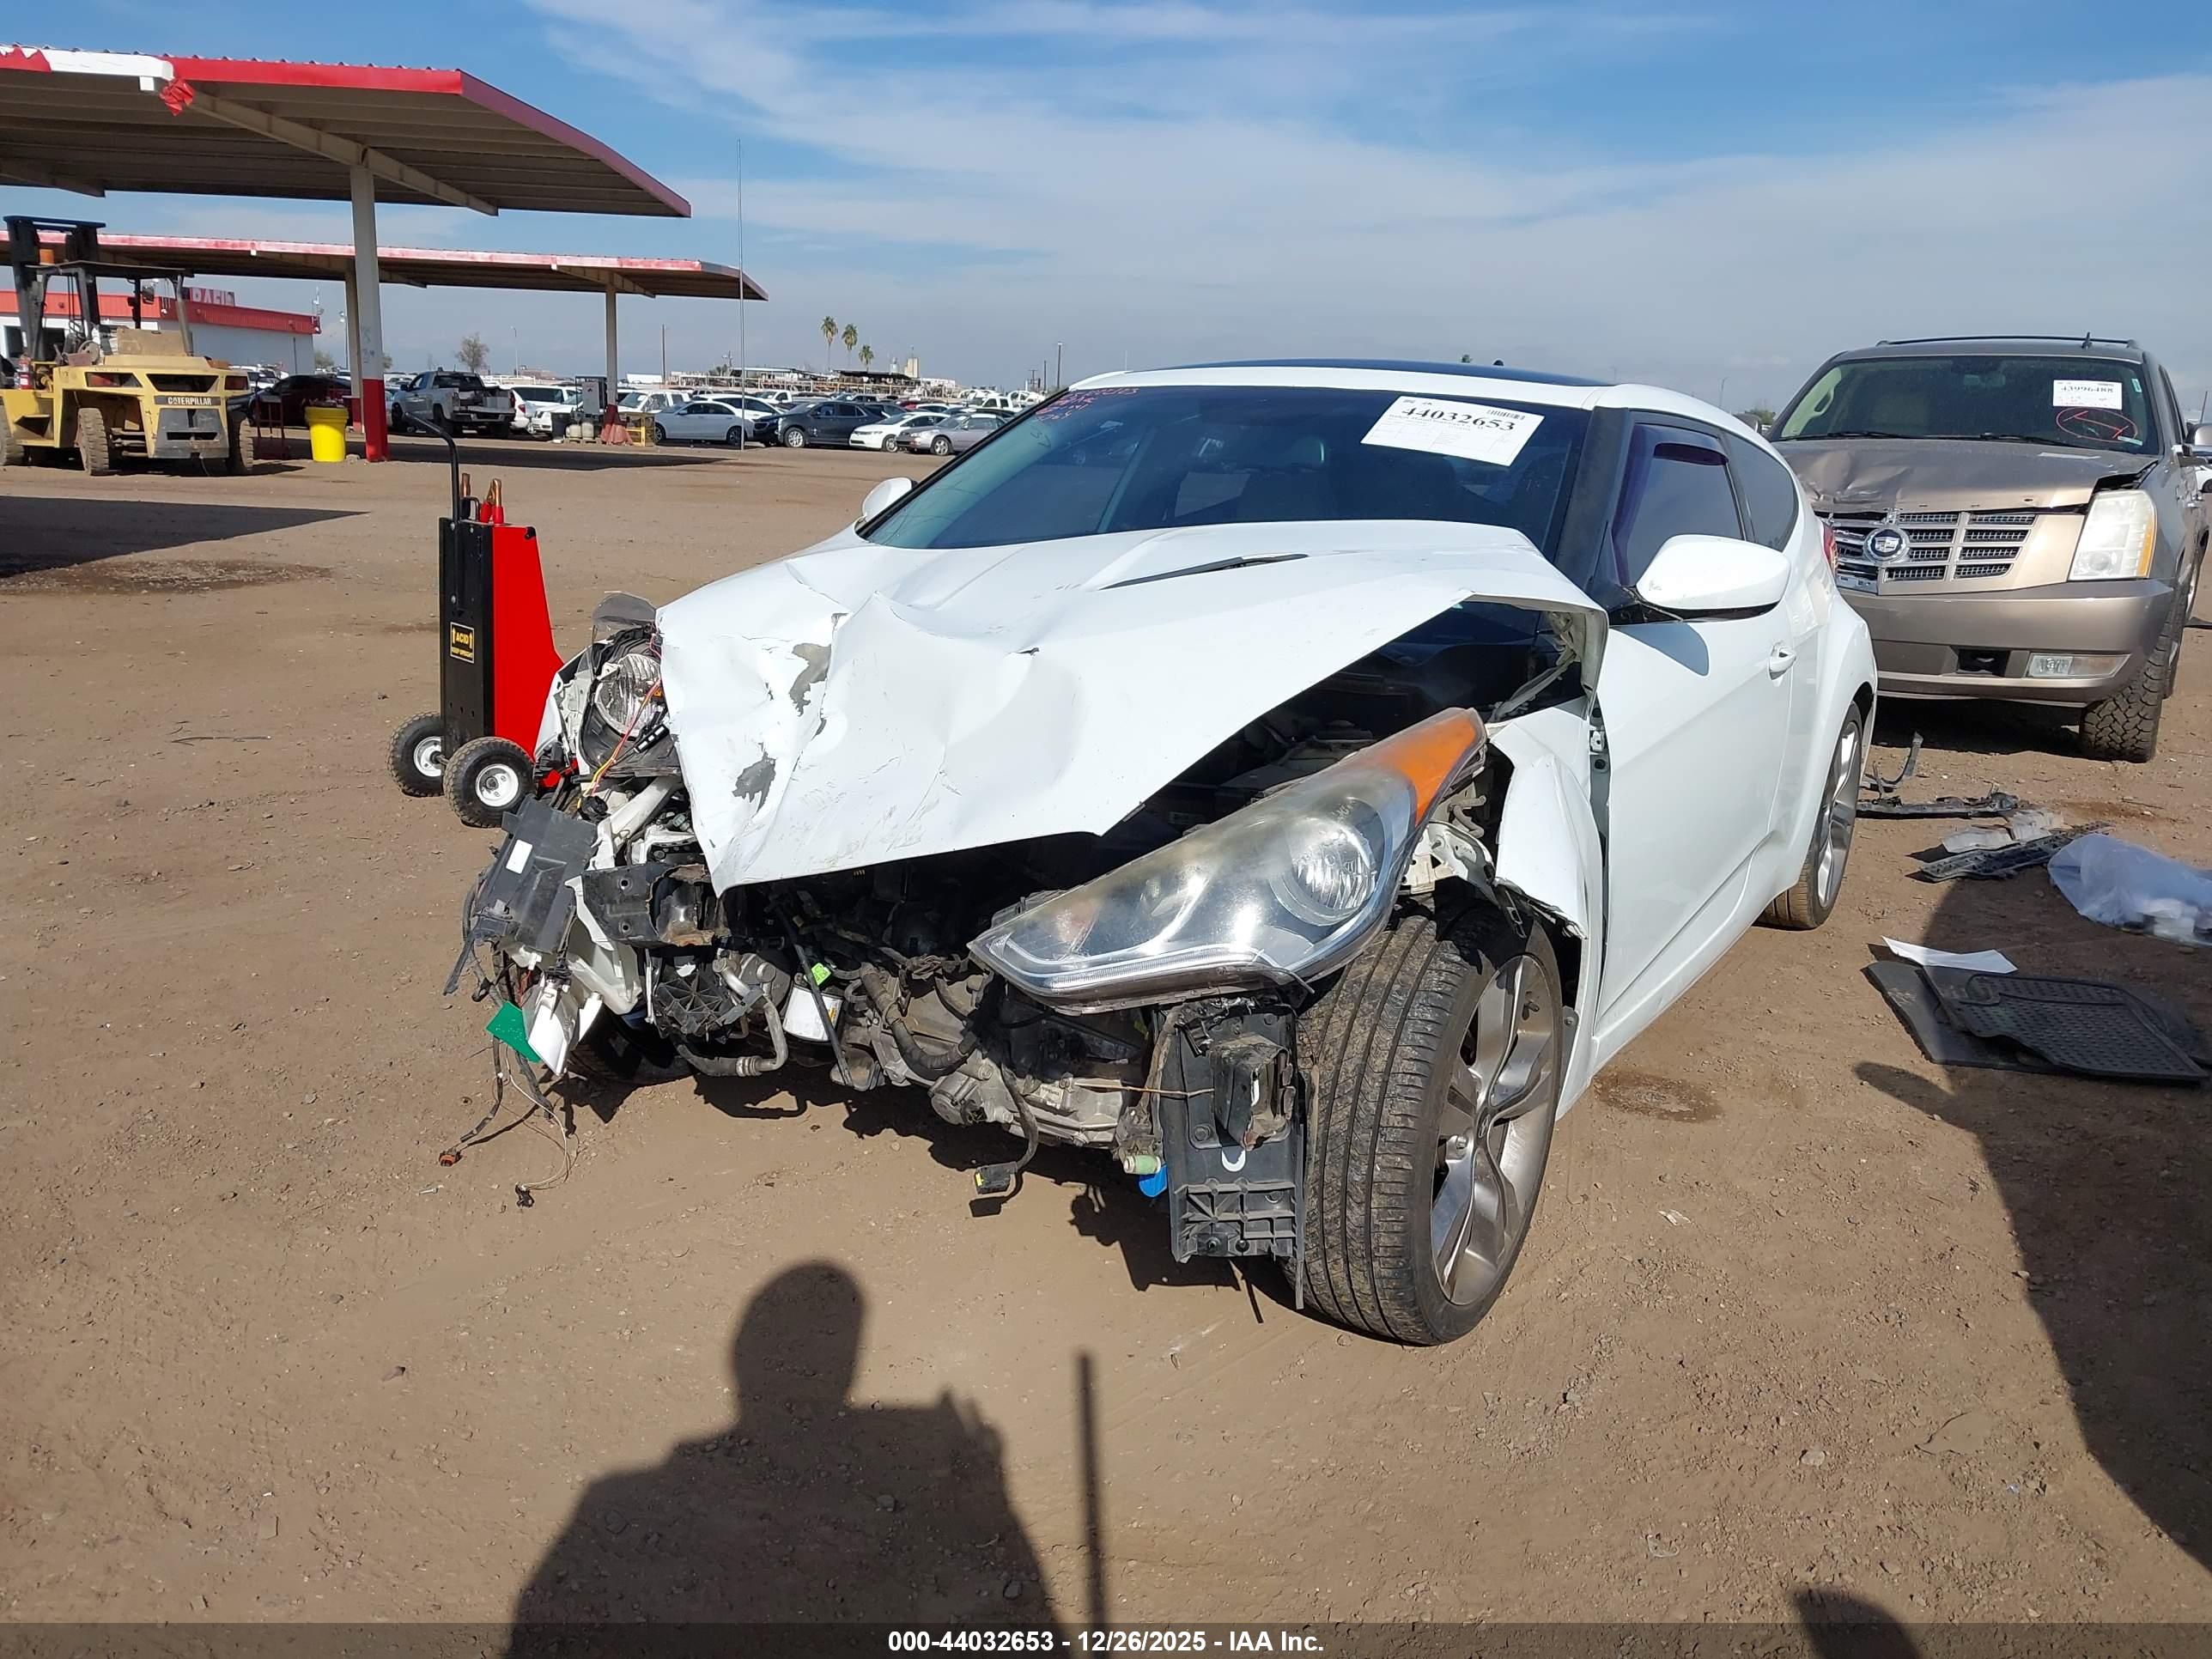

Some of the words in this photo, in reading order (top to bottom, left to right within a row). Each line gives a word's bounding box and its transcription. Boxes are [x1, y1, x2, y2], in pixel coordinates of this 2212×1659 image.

[167, 397, 211, 405] CATERPILLAR
[1402, 407, 1516, 431] 44032653
[455, 632, 469, 644] ACID
